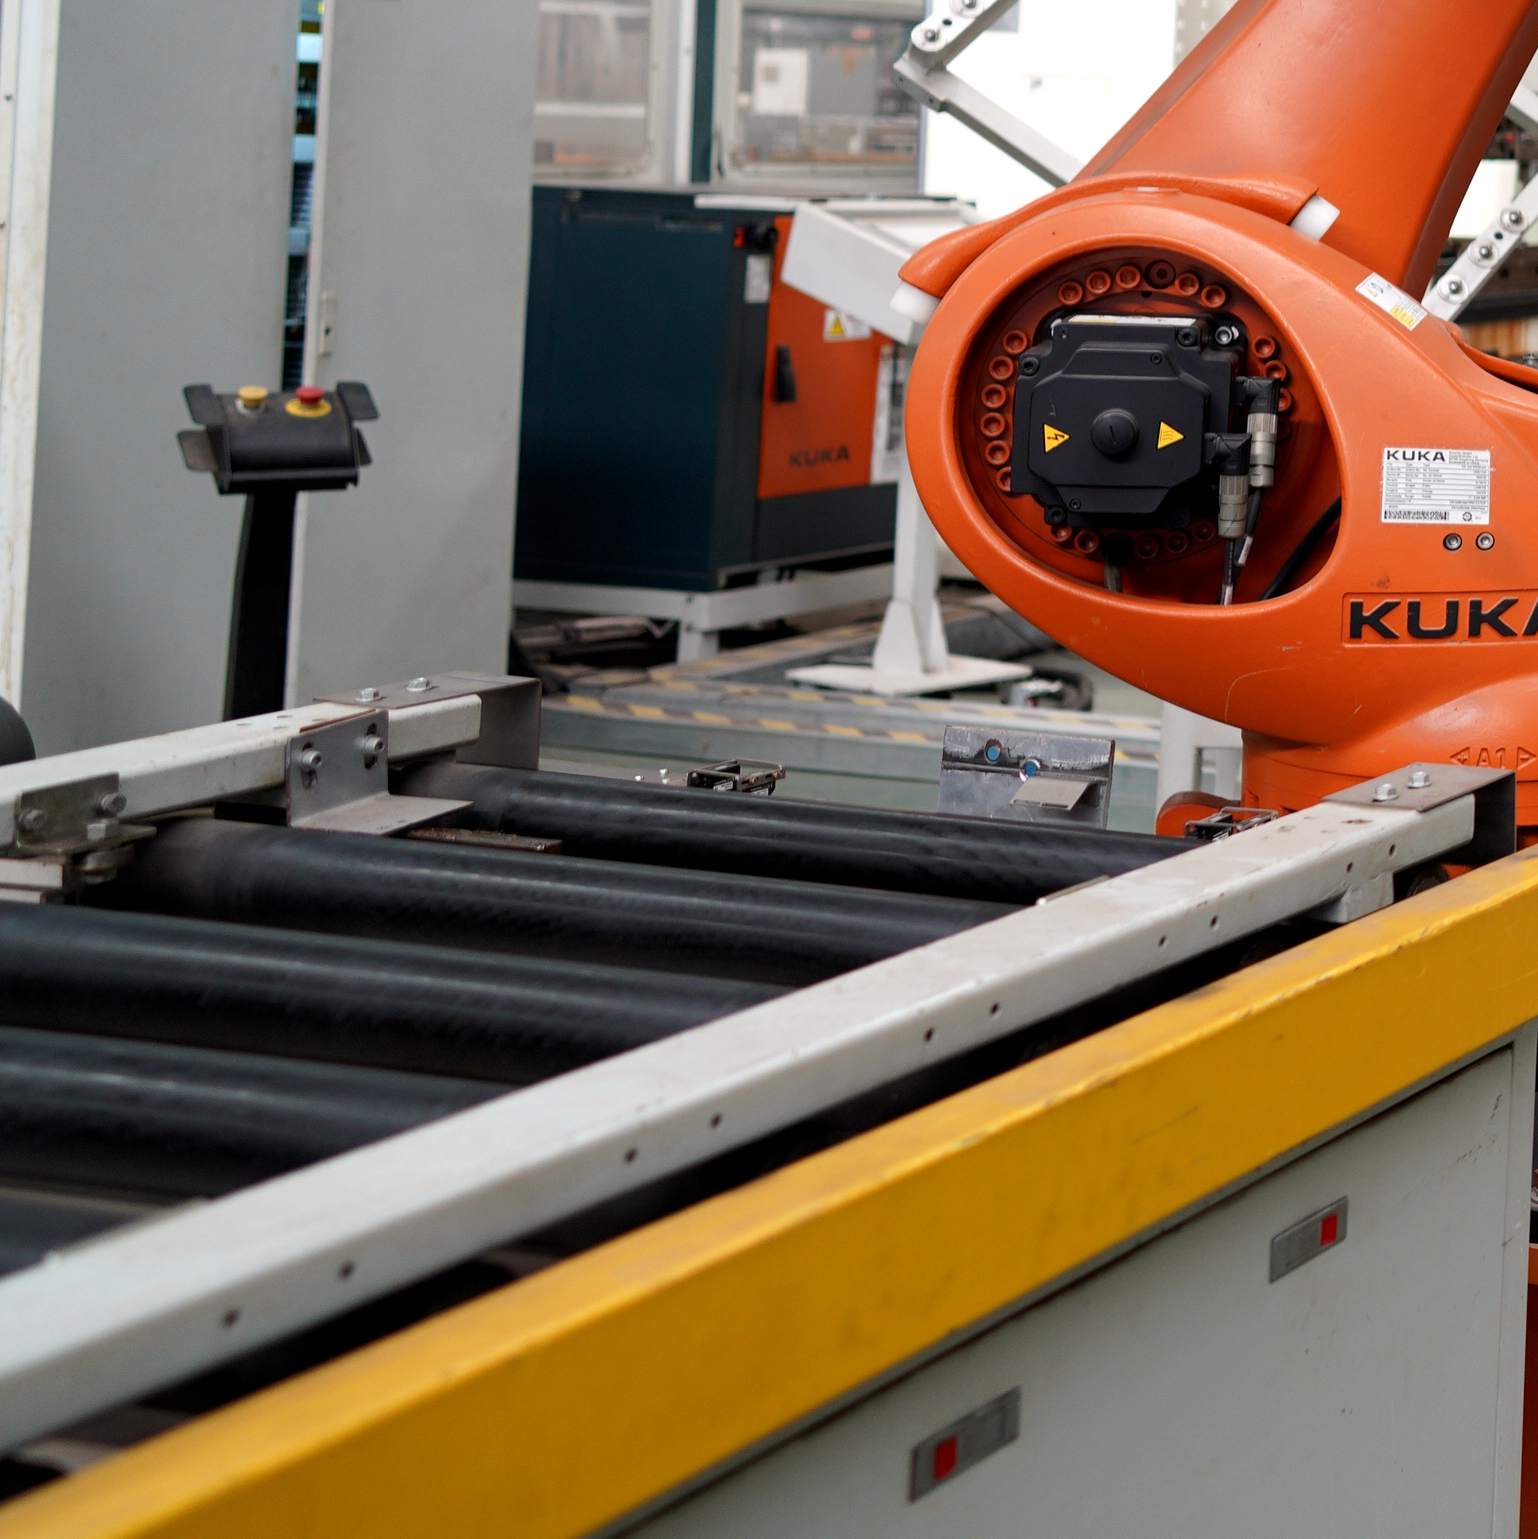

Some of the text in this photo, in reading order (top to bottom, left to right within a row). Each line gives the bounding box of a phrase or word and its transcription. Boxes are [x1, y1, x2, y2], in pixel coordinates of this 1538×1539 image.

[788, 445, 851, 468] KUKA
[1387, 449, 1446, 462] KUKA
[1476, 747, 1507, 769] A1
